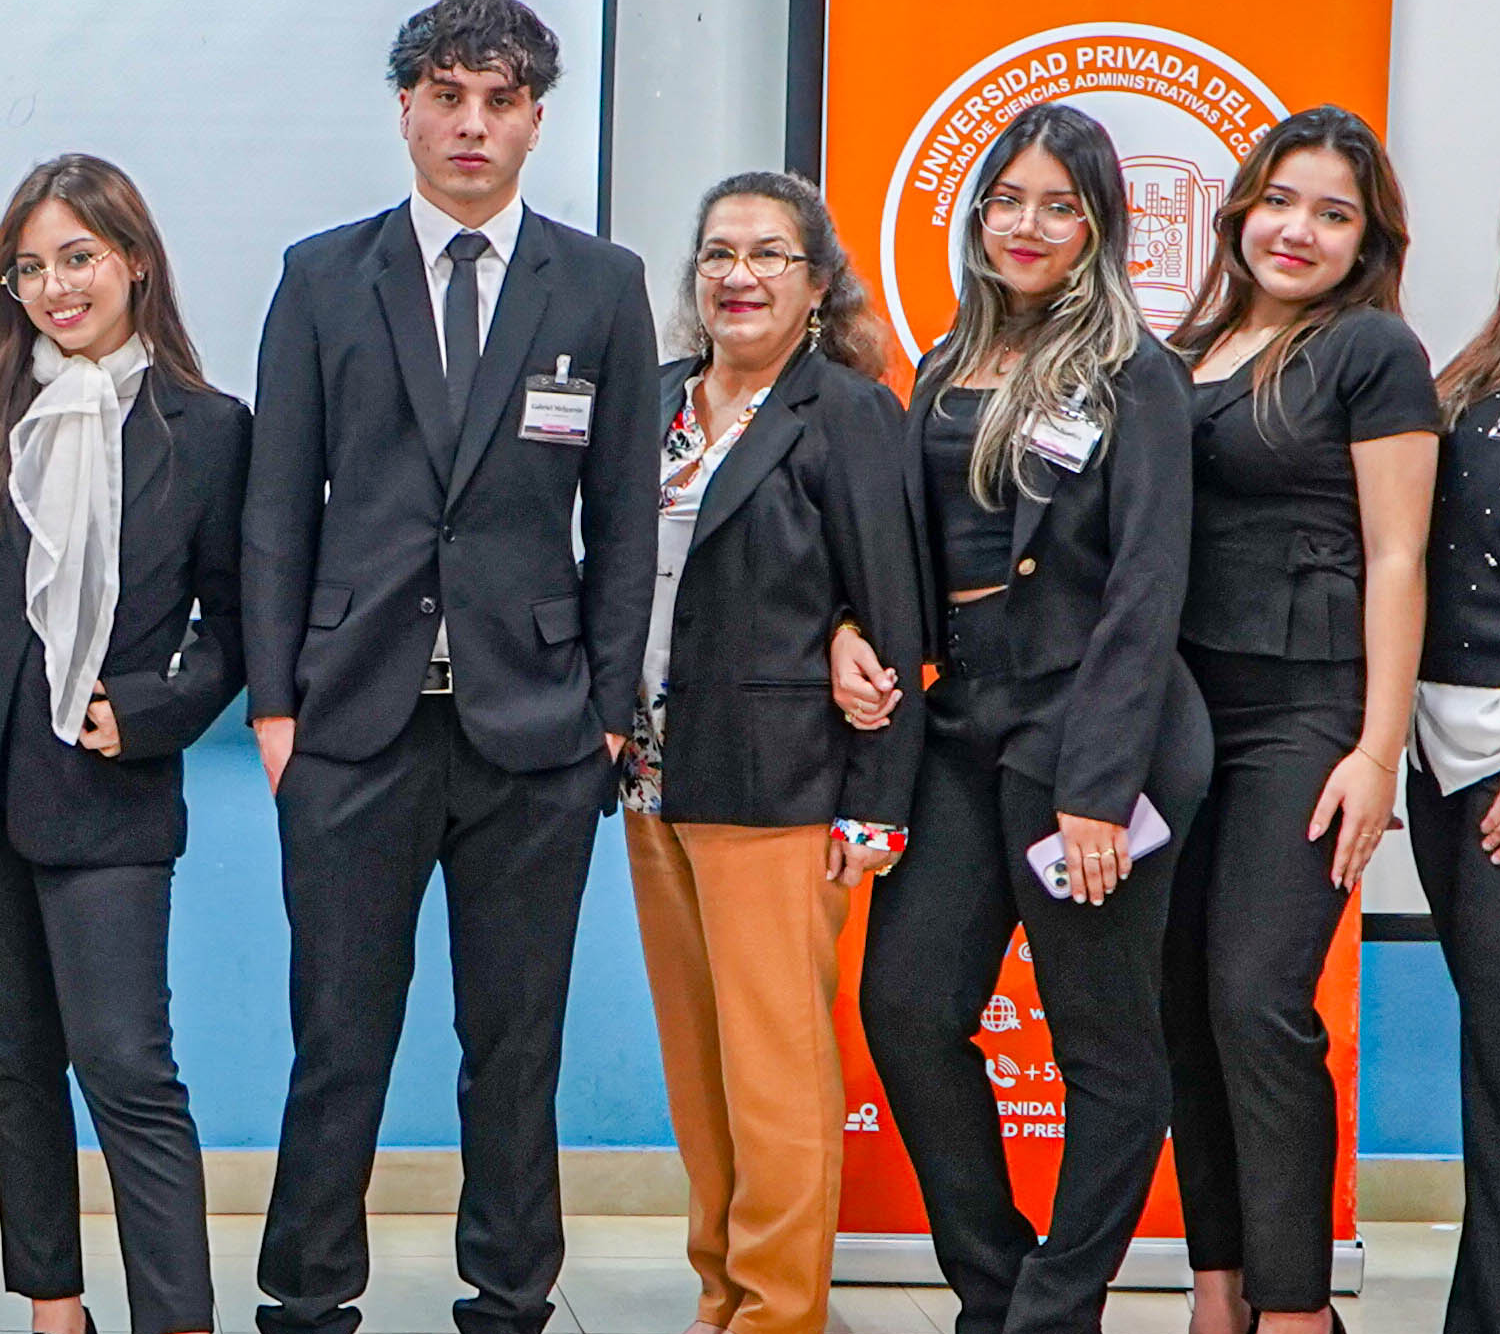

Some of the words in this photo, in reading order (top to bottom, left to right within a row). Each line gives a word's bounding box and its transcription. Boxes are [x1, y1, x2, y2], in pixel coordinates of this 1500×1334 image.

[914, 52, 1068, 192] UNIVERSIDAD
[1076, 45, 1200, 89] PRIVADA
[1203, 76, 1252, 128] DEL
[932, 143, 977, 227] FACULTAD
[972, 120, 997, 144] DE
[995, 78, 1071, 123] CIENCIAS
[1074, 72, 1221, 124] ADMINISTRATIVAS
[1219, 119, 1234, 134] Y
[997, 1101, 1056, 1116] ENIDA
